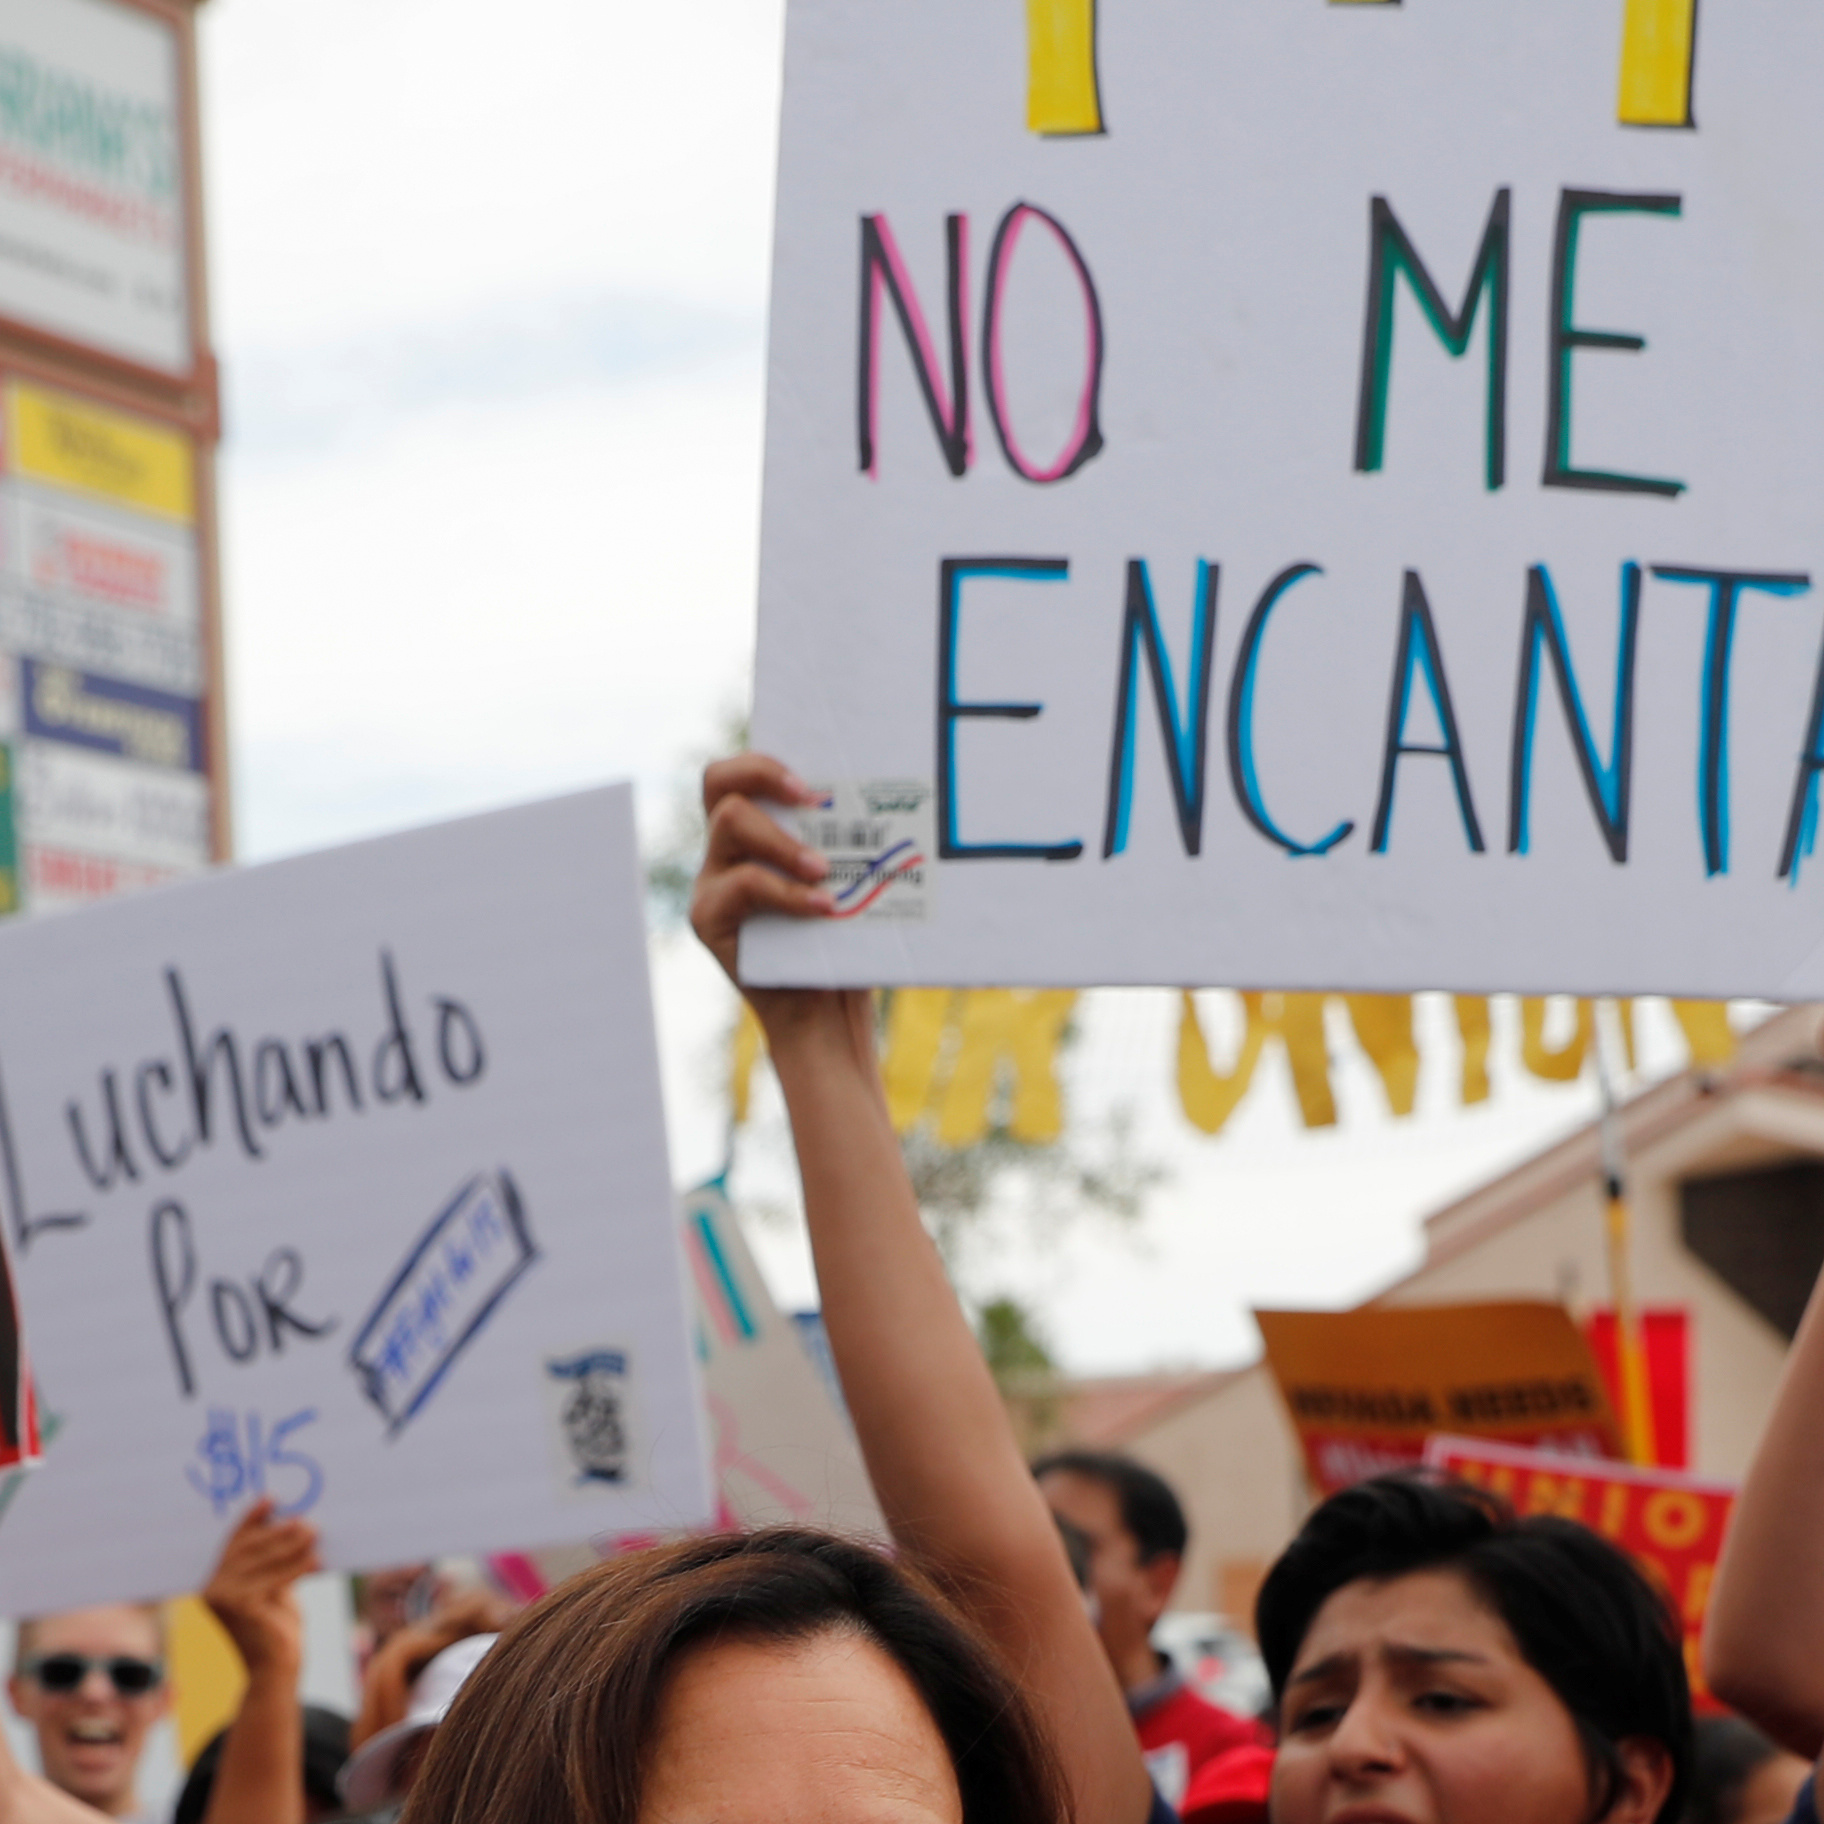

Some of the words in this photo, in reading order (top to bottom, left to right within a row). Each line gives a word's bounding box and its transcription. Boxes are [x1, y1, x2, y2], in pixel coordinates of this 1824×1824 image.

[857, 201, 1105, 481] NO
[1354, 186, 1688, 499] ME
[187, 1407, 325, 1517] $15
[1460, 1455, 1714, 1551] UNIO
